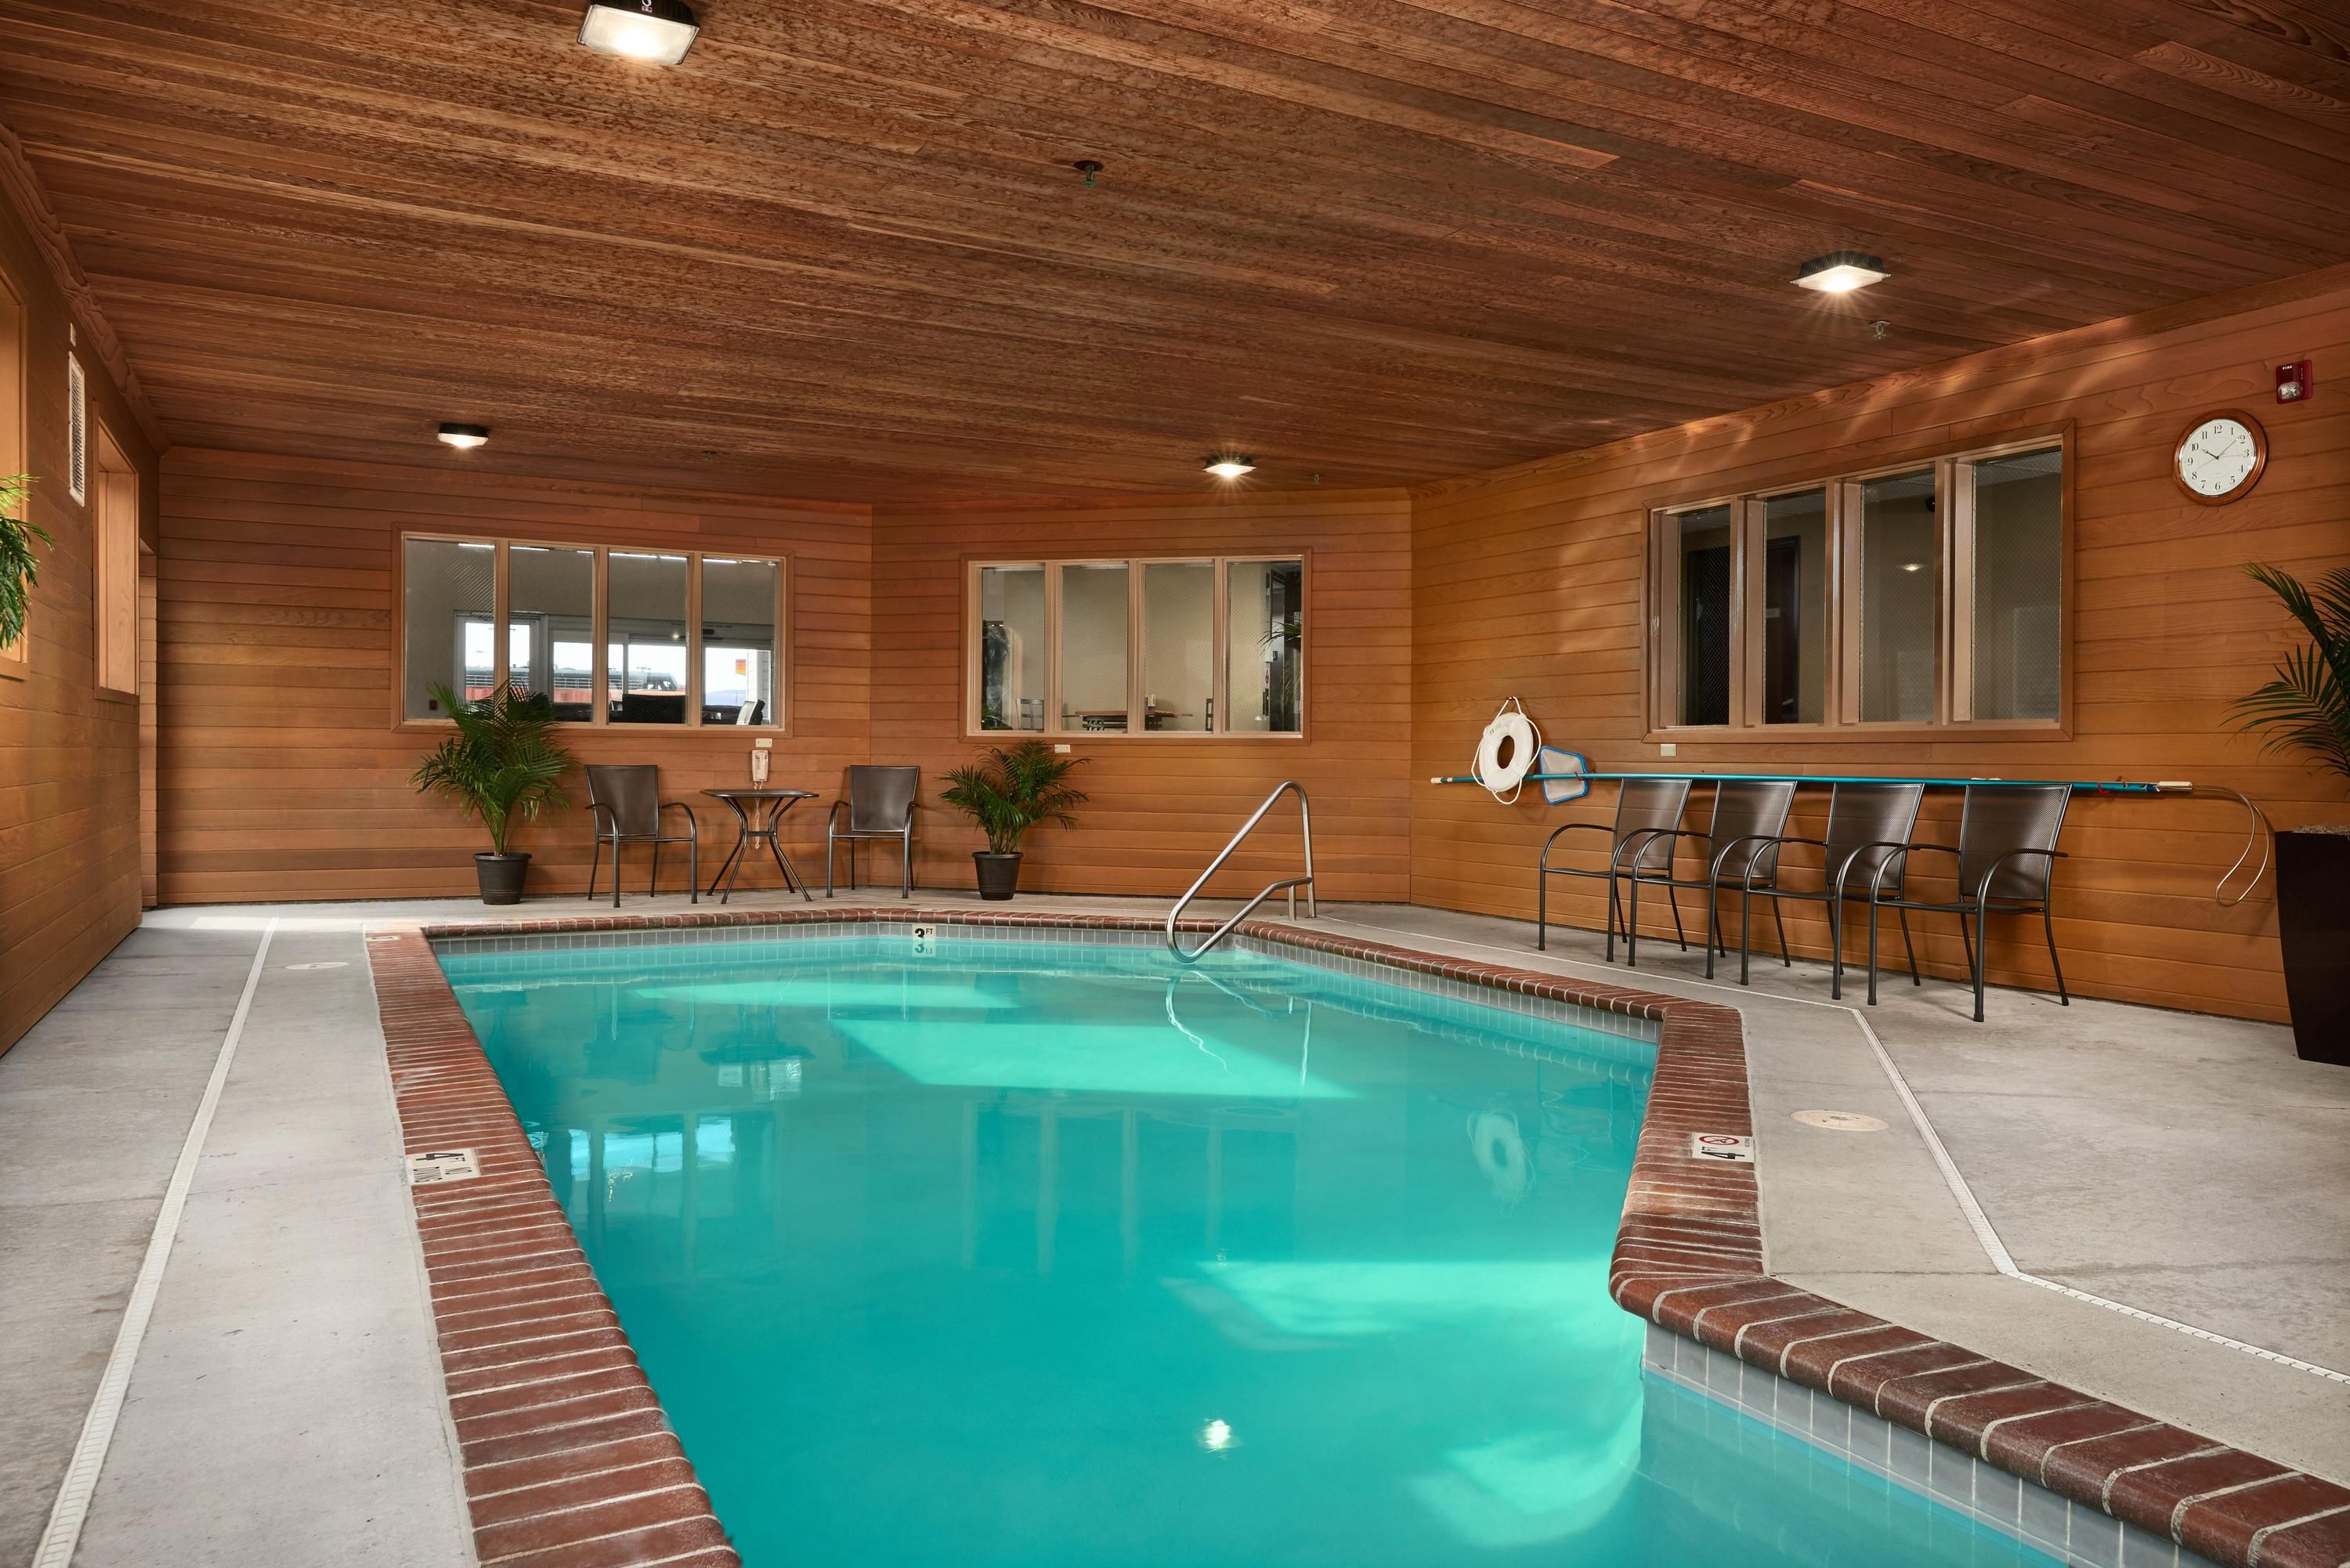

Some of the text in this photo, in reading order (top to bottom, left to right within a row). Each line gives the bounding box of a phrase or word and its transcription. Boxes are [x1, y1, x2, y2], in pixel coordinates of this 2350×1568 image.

[2214, 425, 2222, 434] 12
[2202, 431, 2207, 439] 11
[2240, 435, 2246, 444] 2
[2192, 443, 2199, 451] 10
[2243, 449, 2250, 457] 3
[2187, 457, 2193, 466] 9
[2239, 464, 2243, 473] 4
[2192, 471, 2197, 479] 8
[2200, 479, 2207, 489] 7
[2229, 475, 2236, 485] 5
[2214, 482, 2221, 490] 6
